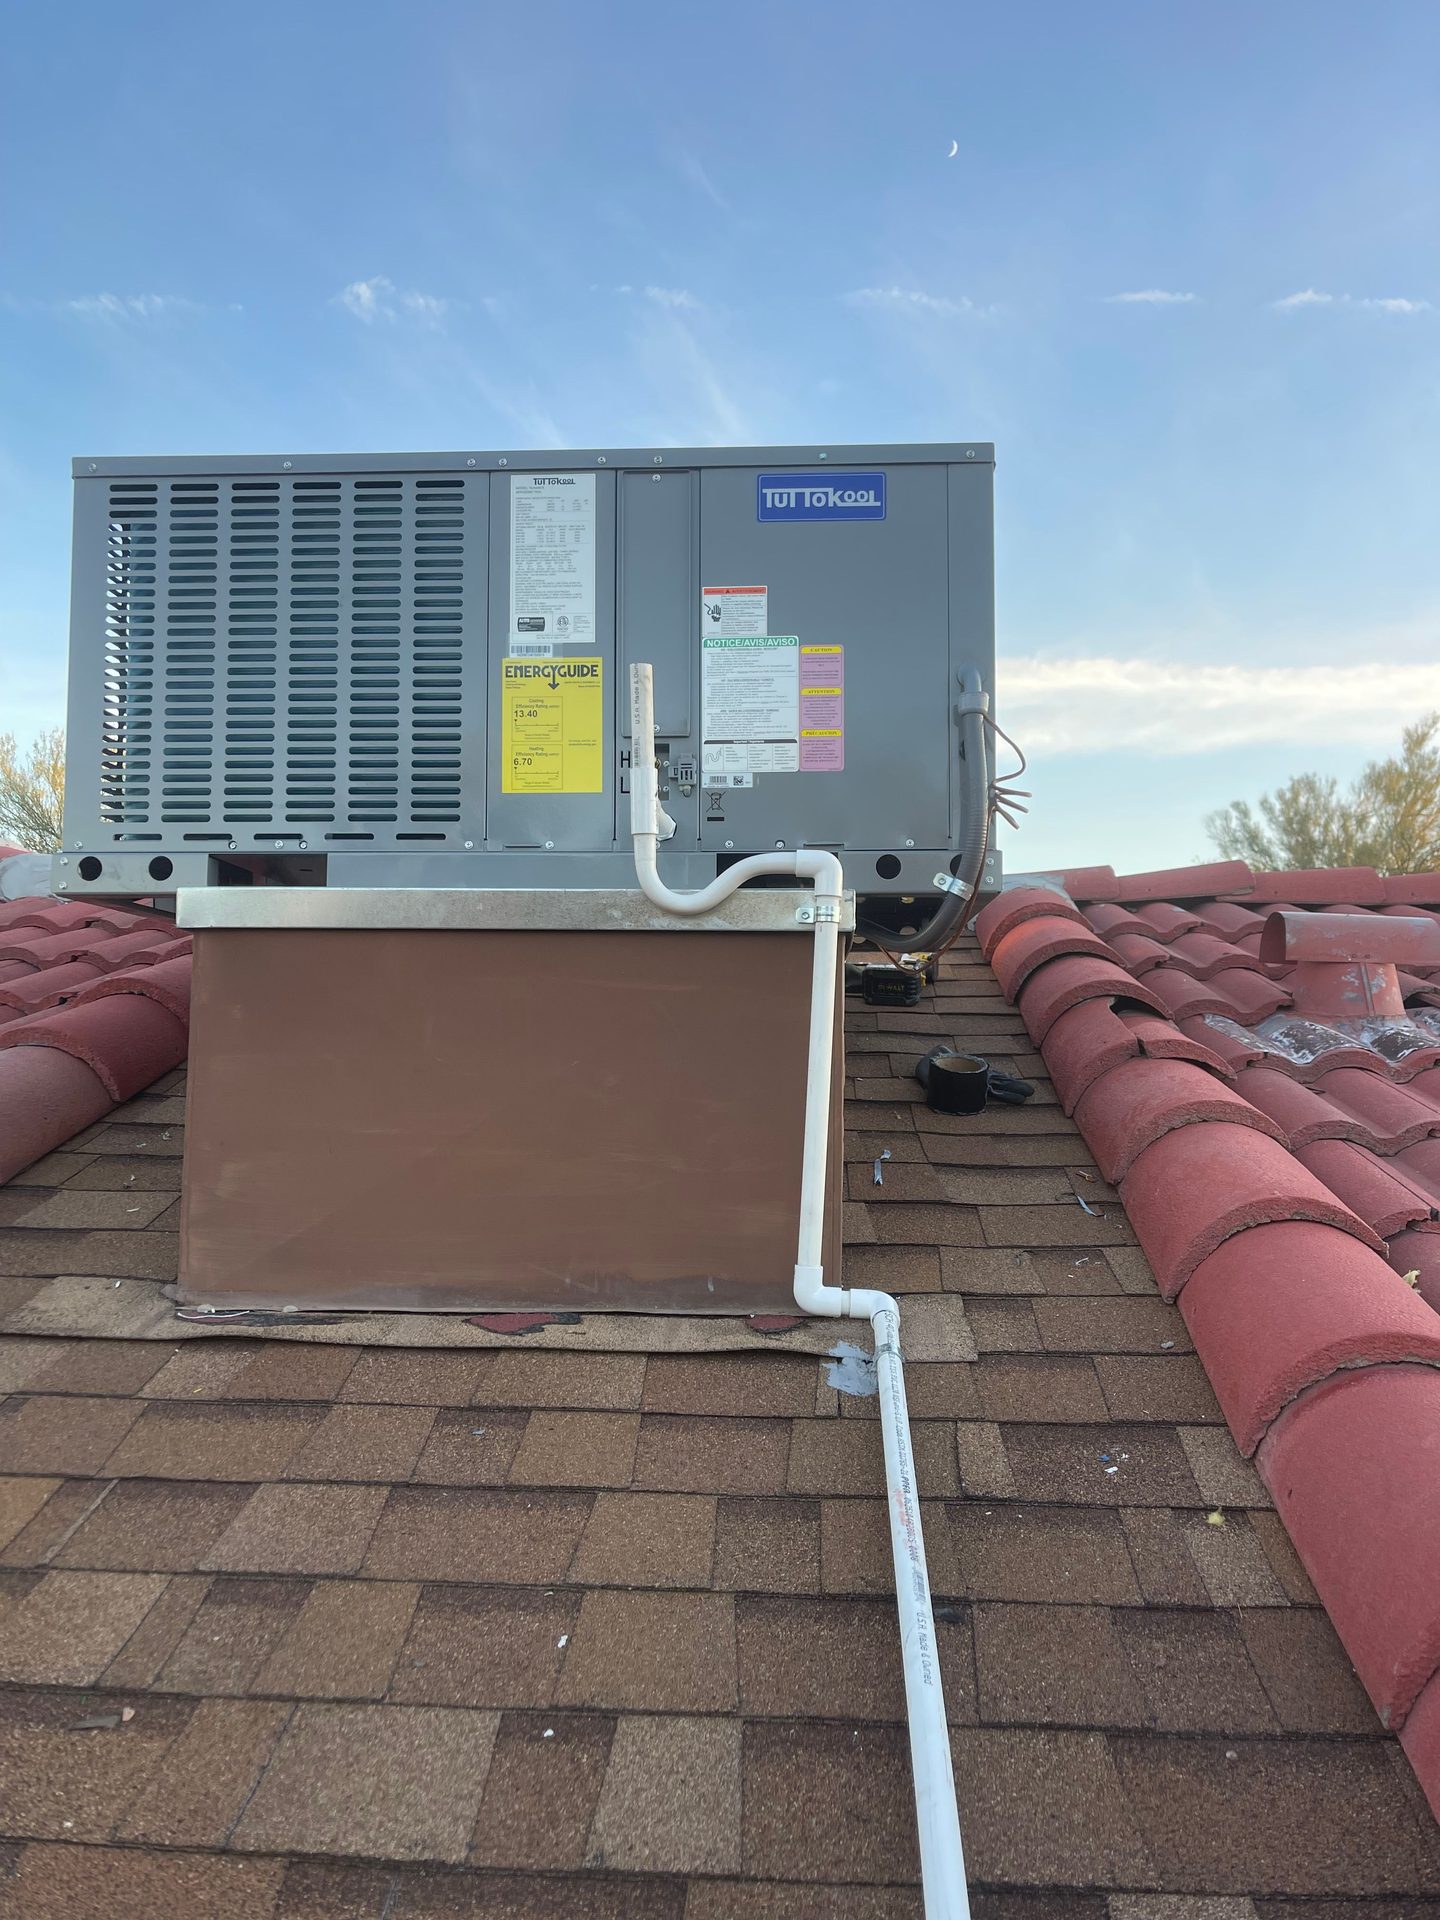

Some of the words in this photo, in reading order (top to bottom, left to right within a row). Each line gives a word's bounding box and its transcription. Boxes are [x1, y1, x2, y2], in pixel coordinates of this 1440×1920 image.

[706, 638, 796, 647] NOTICE/AVIS/AVISO
[505, 664, 599, 679] ENERGYGUIDE
[514, 709, 538, 718] 13.40
[513, 757, 533, 766] 6.70
[918, 1632, 929, 1651] Made
